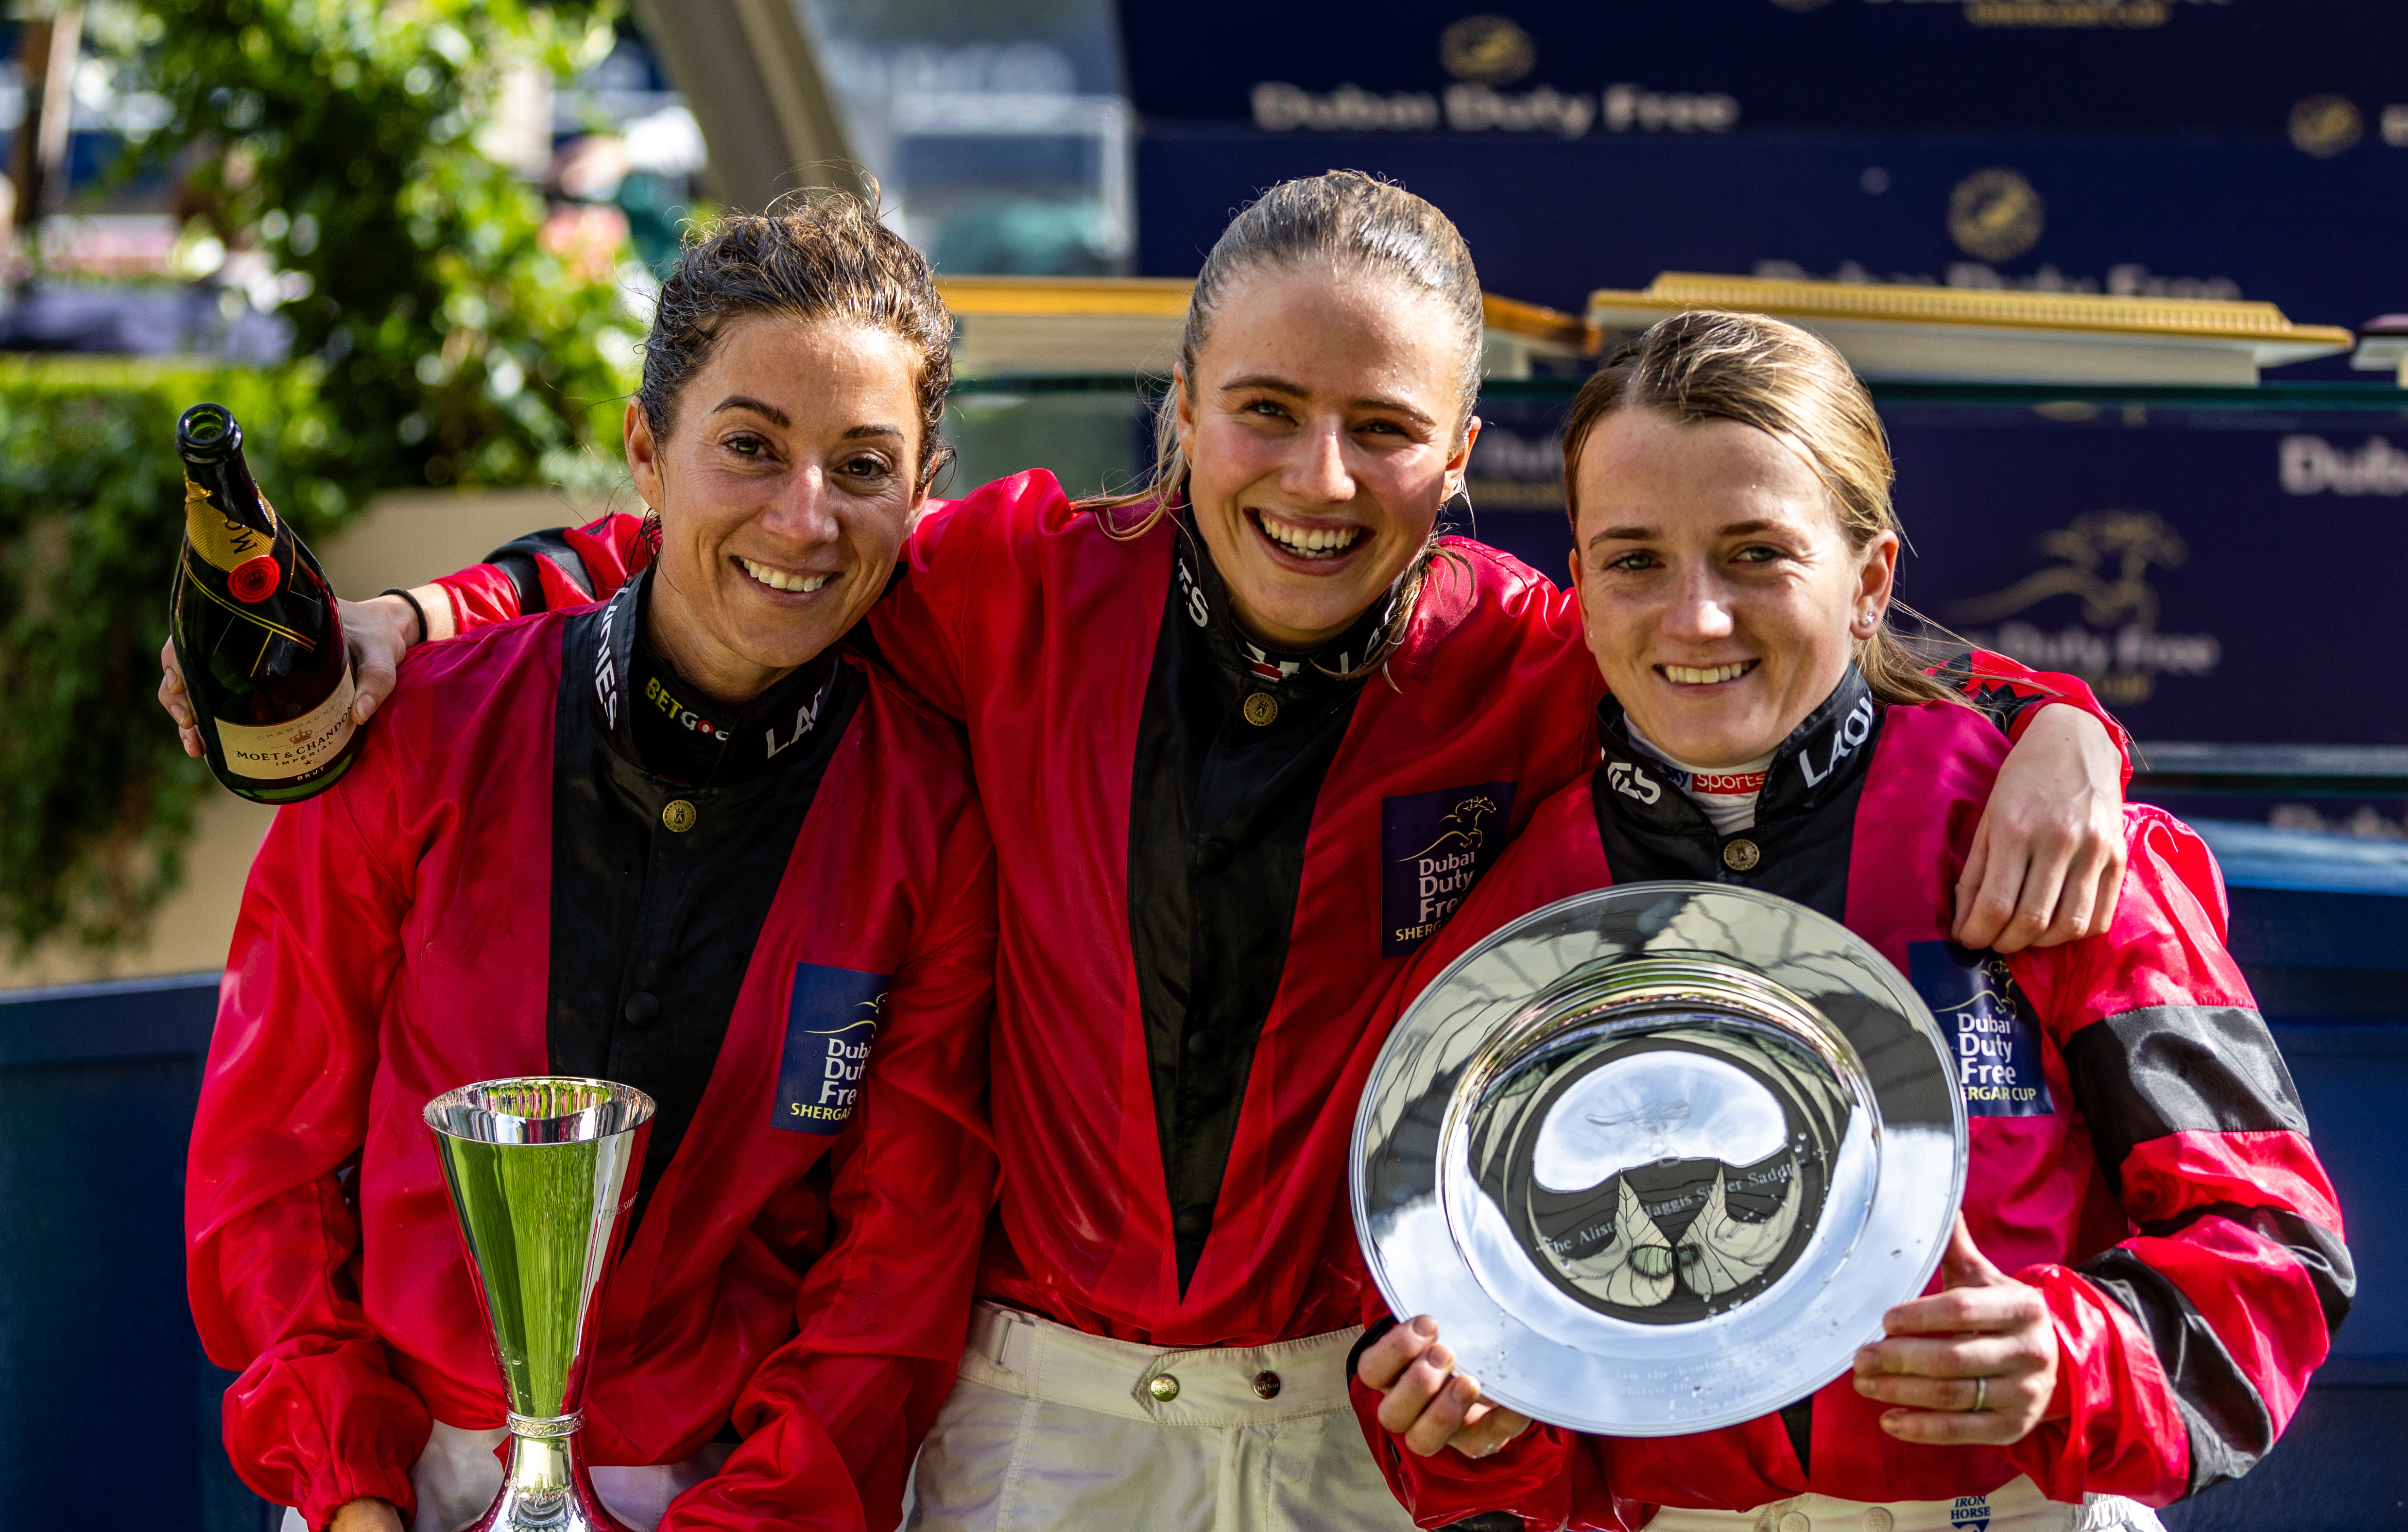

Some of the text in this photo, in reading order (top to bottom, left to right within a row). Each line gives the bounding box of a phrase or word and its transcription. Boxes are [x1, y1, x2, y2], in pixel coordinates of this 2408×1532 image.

[237, 750, 280, 761] MOËT
[296, 703, 352, 755] CHANDON
[257, 705, 335, 740] CHAMPAGNE
[275, 741, 334, 766] IMPÉRIAL
[297, 766, 325, 781] BRUT
[1696, 773, 1766, 792] sports
[1418, 851, 1475, 876] Dubai
[1418, 868, 1475, 898] Duty
[1957, 1013, 2011, 1035] Dubai
[1958, 1033, 2012, 1063] Duty
[824, 1056, 866, 1081] Dut
[1960, 1057, 2016, 1085] Free
[818, 1080, 858, 1106] Fre
[2012, 1087, 2037, 1101] CUP
[603, 1205, 622, 1220] THE
[1950, 1506, 1991, 1520] HORSE
[1954, 1495, 1987, 1508] IRON
